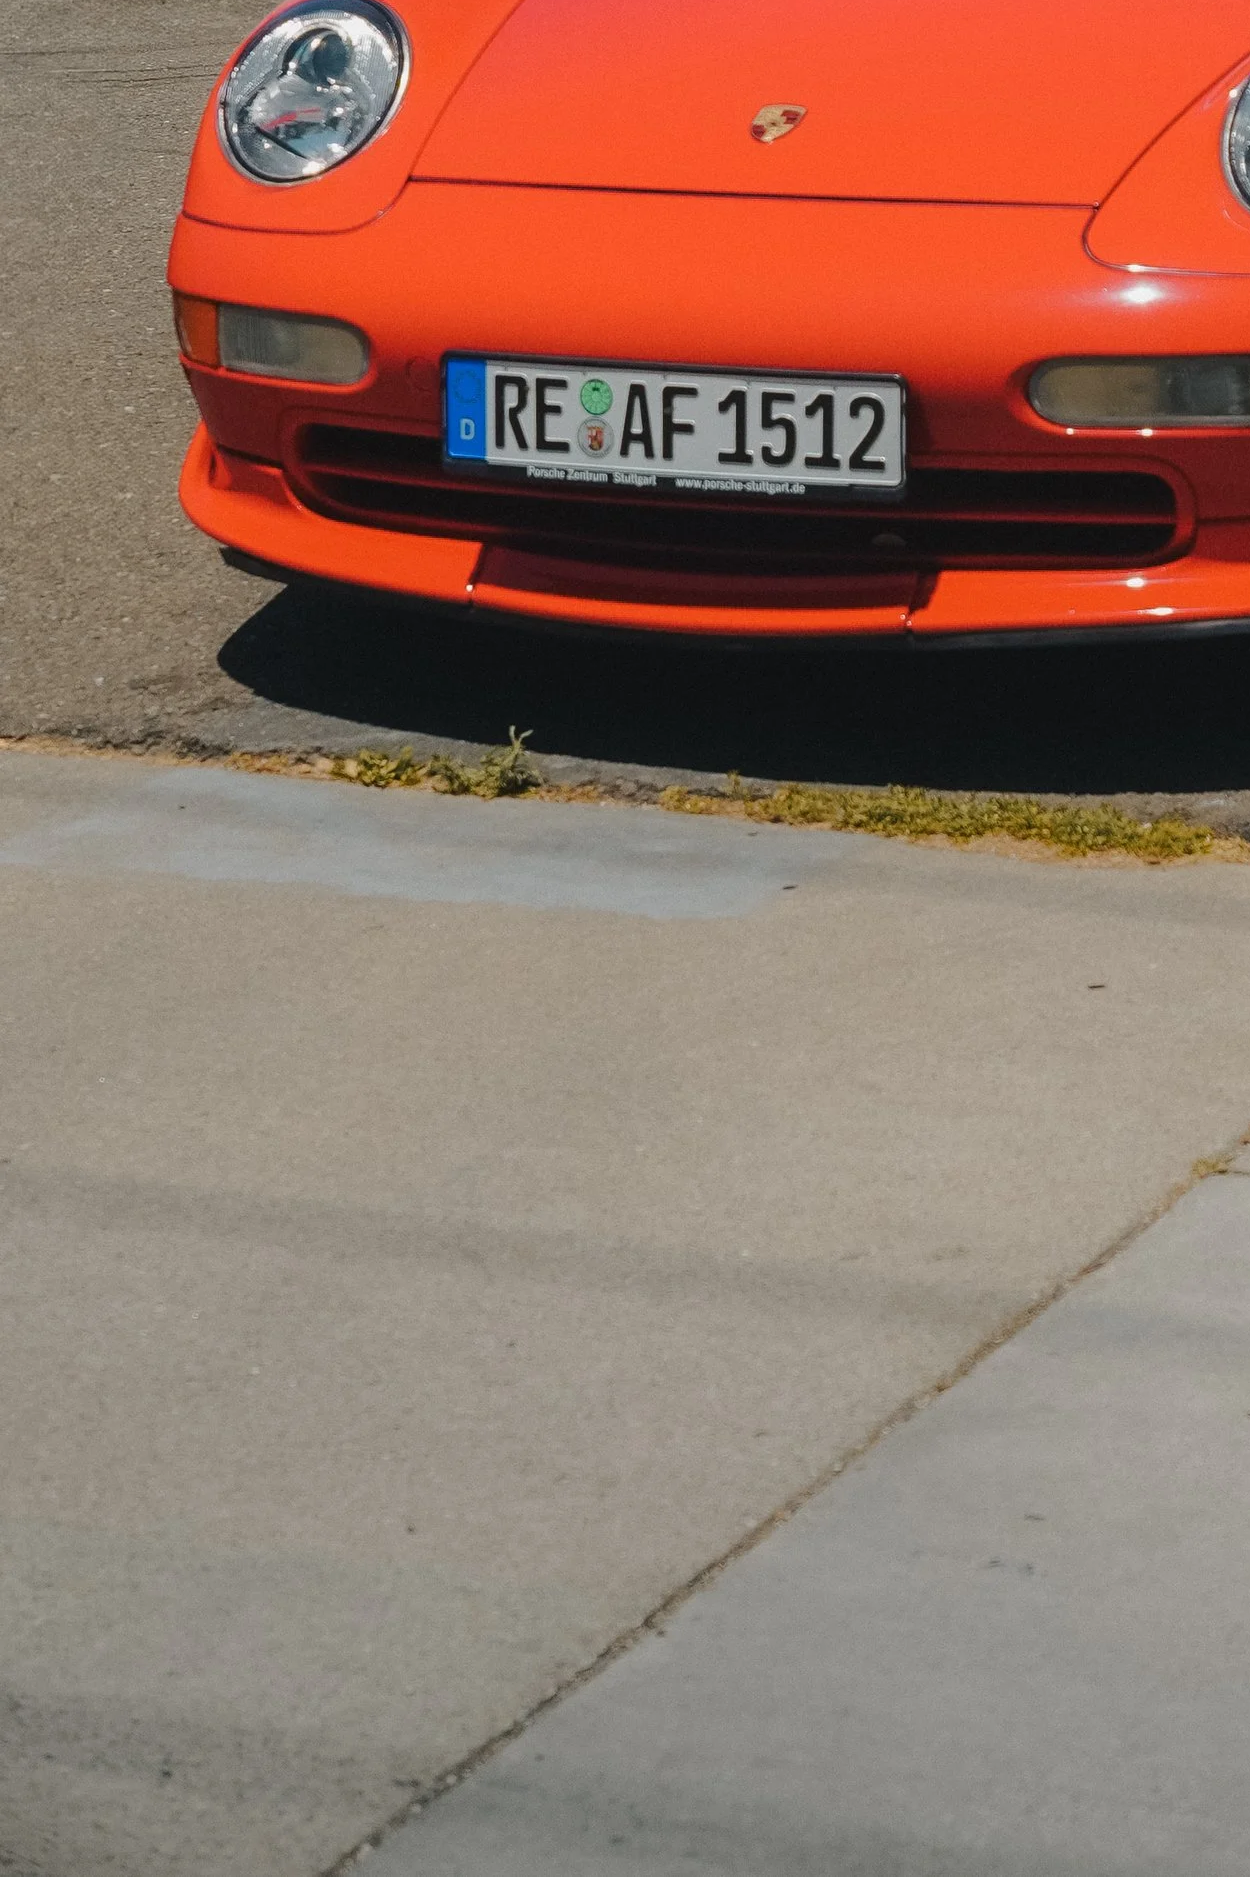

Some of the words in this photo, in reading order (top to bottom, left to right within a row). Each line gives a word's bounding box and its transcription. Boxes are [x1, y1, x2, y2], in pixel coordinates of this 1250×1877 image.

[461, 418, 475, 440] D
[495, 374, 570, 452] RE
[620, 382, 699, 460] AF
[718, 389, 886, 470] 1512
[527, 465, 566, 480] Porsche
[566, 468, 609, 483] Zentrum
[612, 471, 657, 487] Stuttgart
[675, 478, 806, 495] www.porsche-stuttgart.de
